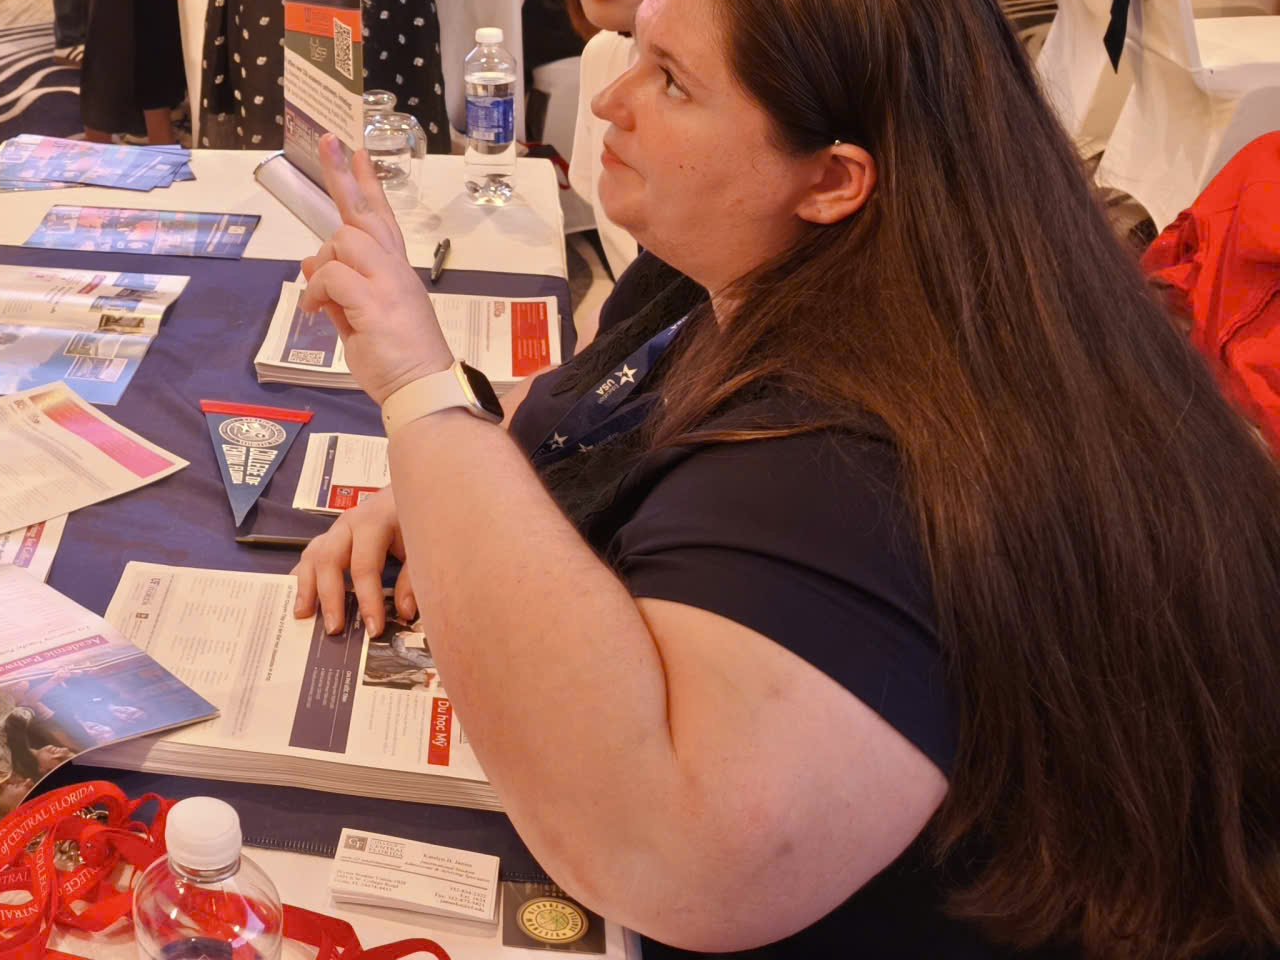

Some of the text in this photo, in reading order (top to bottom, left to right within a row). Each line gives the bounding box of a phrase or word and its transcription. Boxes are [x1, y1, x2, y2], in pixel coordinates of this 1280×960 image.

[595, 378, 616, 395] USA
[247, 447, 278, 477] COLLEGE
[46, 636, 102, 658] Academic
[431, 700, 450, 748] Du học Mỹ
[7, 811, 50, 846] CENTRAL
[49, 784, 96, 816] FLORIDA
[0, 903, 40, 921] NTRAL
